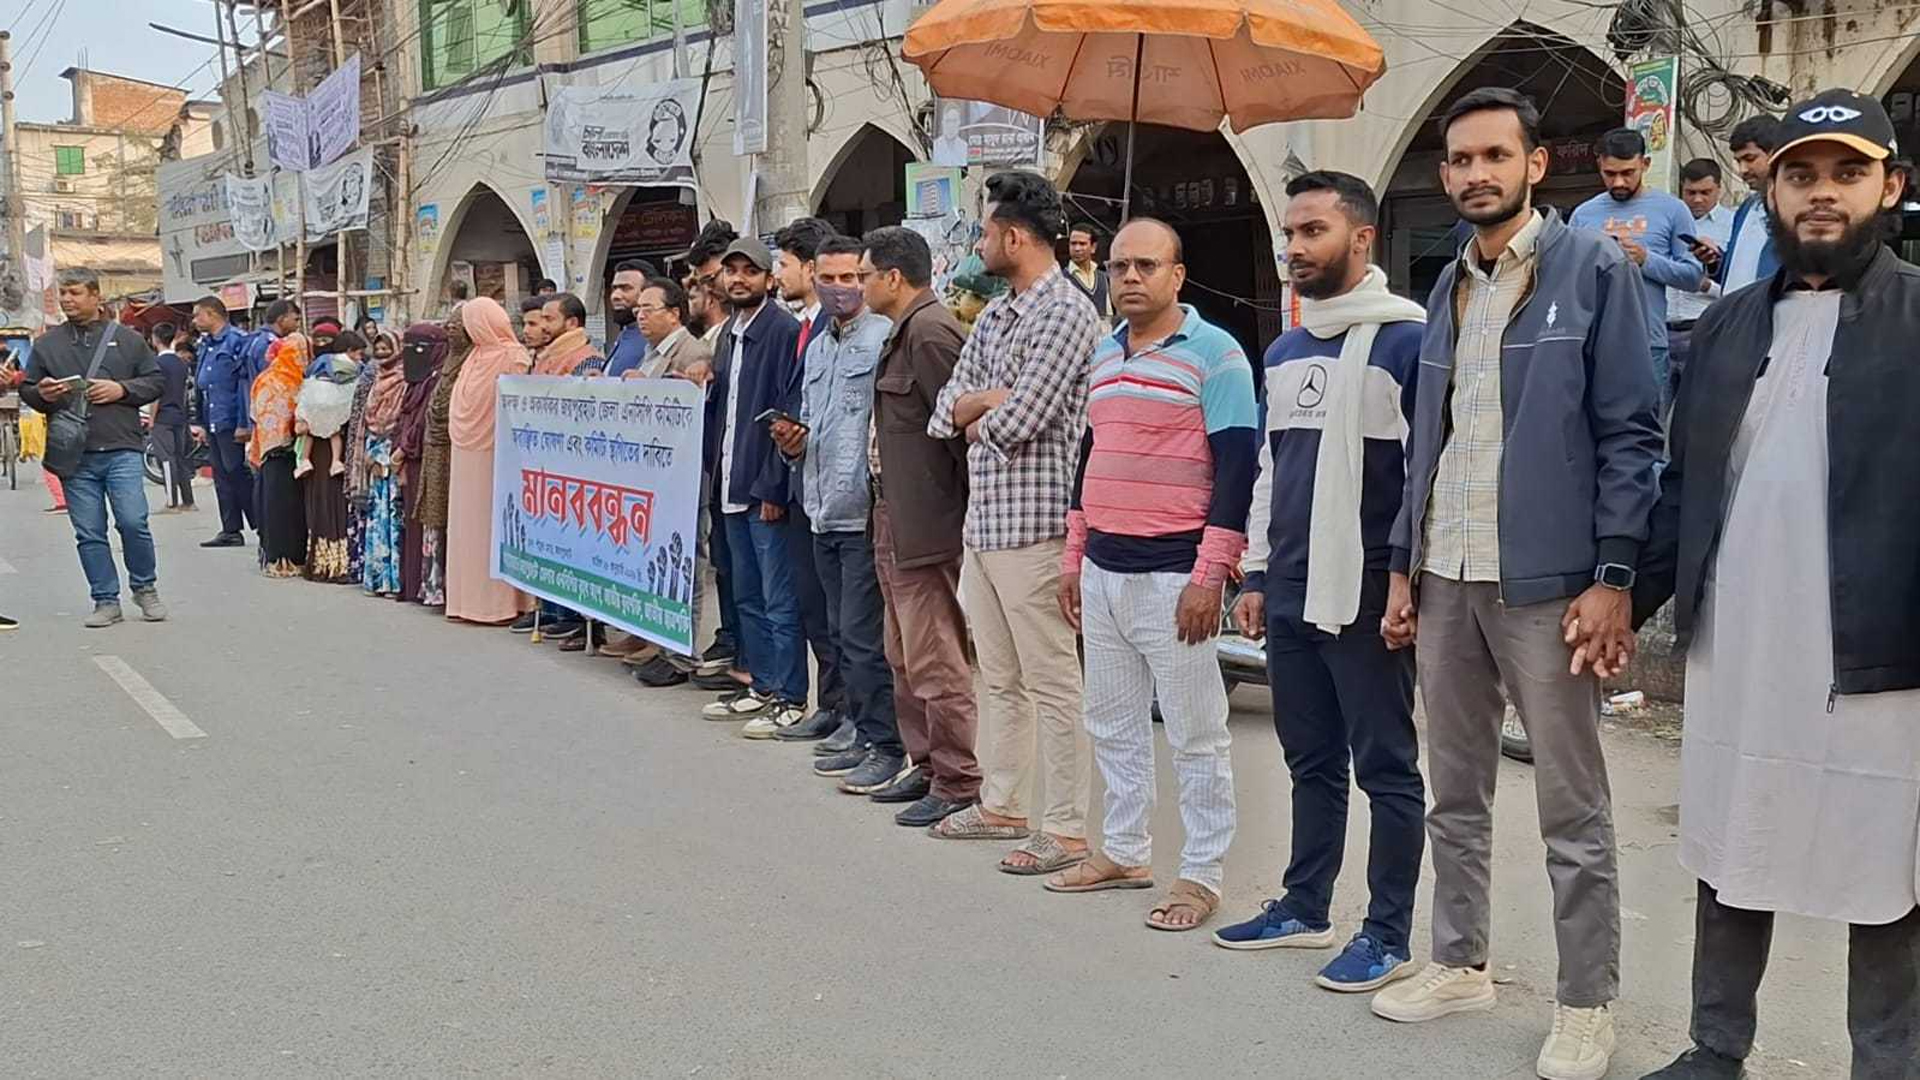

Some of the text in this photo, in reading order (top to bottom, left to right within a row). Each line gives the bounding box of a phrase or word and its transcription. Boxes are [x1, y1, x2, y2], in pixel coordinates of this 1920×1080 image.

[599, 401, 619, 422] জেলা
[567, 435, 583, 460] এবং
[521, 466, 654, 547] মানববন্ধন
